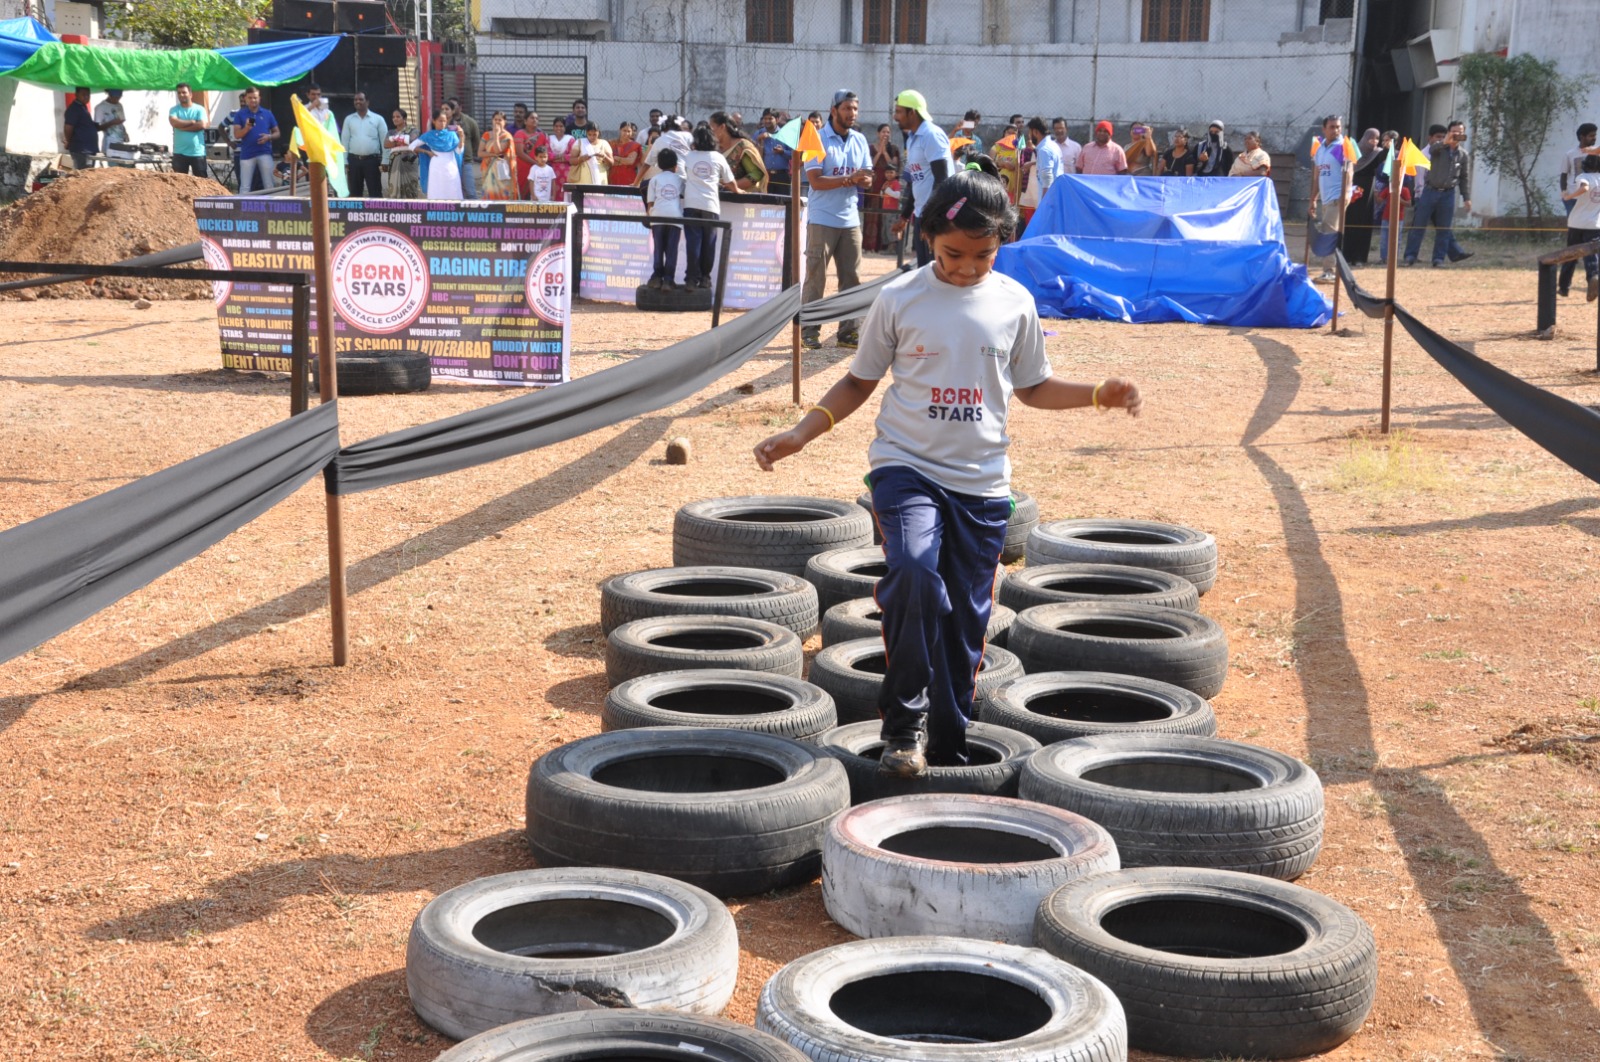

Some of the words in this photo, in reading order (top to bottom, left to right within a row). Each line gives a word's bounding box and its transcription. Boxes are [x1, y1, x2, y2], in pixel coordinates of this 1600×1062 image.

[194, 201, 215, 209] MUDDY
[215, 202, 234, 210] WATER
[241, 201, 267, 212] DARK
[268, 202, 303, 214] TUNNEL
[337, 201, 363, 210] SPORTS
[364, 201, 406, 210] CHALLENGE
[408, 202, 429, 211] YOUR
[430, 203, 456, 211] LIMITS
[505, 205, 537, 213] WONDER
[538, 206, 566, 214] SPORTS
[347, 212, 388, 222] OBSTACLE
[389, 214, 422, 223] COURSE
[426, 211, 465, 222] MUDDY
[467, 213, 503, 223] WATER
[196, 218, 234, 231] WICKED
[235, 220, 259, 233] WEB
[410, 225, 448, 238] FITTEST
[450, 227, 489, 239] SCHOOL
[491, 228, 502, 239] IN
[503, 228, 561, 241] HYDERABAD
[222, 239, 251, 248] BARBED
[252, 240, 272, 249] WIRE
[276, 241, 301, 250] NEVER
[422, 240, 463, 252] OBSTACLE
[464, 242, 497, 253] COURSE
[501, 242, 523, 252] DON'T
[525, 243, 543, 253] QUIT
[233, 252, 285, 269] BEASTLY
[336, 255, 347, 271] THE
[346, 235, 387, 253] ULTIMATE
[388, 237, 421, 274] MILITARY
[351, 264, 404, 281] BORN
[429, 256, 492, 277] RAGING
[494, 259, 528, 279] FIRE
[532, 264, 541, 278] THE
[351, 282, 407, 297] STARS
[432, 282, 457, 291] TRIDENT
[458, 283, 503, 292] INTERNATIONAL
[431, 292, 449, 302] HBC
[475, 293, 497, 303] NEVER
[498, 294, 513, 303] GIVE
[513, 294, 524, 303] UP
[226, 305, 242, 315] HBC
[341, 297, 384, 324] OBSTACLE
[385, 299, 417, 324] COURSE
[426, 305, 454, 314] RAGING
[455, 306, 471, 315] FIRE
[535, 297, 565, 319] OBSTACL
[245, 318, 267, 329] YOUR
[268, 319, 293, 331] LIMITS
[419, 316, 436, 325] DARK
[436, 317, 459, 325] TUNNEL
[461, 316, 482, 326] SWEAT
[483, 317, 501, 326] GUTS
[501, 318, 516, 327] AND
[517, 318, 540, 328] GLORY
[222, 329, 244, 338] STARS
[409, 327, 437, 337] WONDER
[438, 328, 462, 338] SPORTS
[481, 328, 497, 338] GIVE
[497, 329, 533, 339] ORDINARY
[534, 330, 541, 339] A
[541, 330, 562, 339] BREAK
[228, 341, 245, 351] GUTS
[246, 343, 259, 352] AND
[260, 344, 281, 353] GLORY
[419, 339, 492, 359] HYDERABAD
[492, 340, 528, 353] MUDDY
[529, 342, 562, 354] WATER
[433, 358, 448, 366] YOUR
[448, 358, 469, 367] LIMITS
[493, 354, 528, 369] DON'T
[530, 355, 559, 371] QUIT
[439, 368, 470, 378] COURSE
[472, 369, 502, 380] BARBED
[503, 371, 524, 380] WIRE
[931, 387, 983, 405] BORN
[928, 404, 983, 422] STARS
